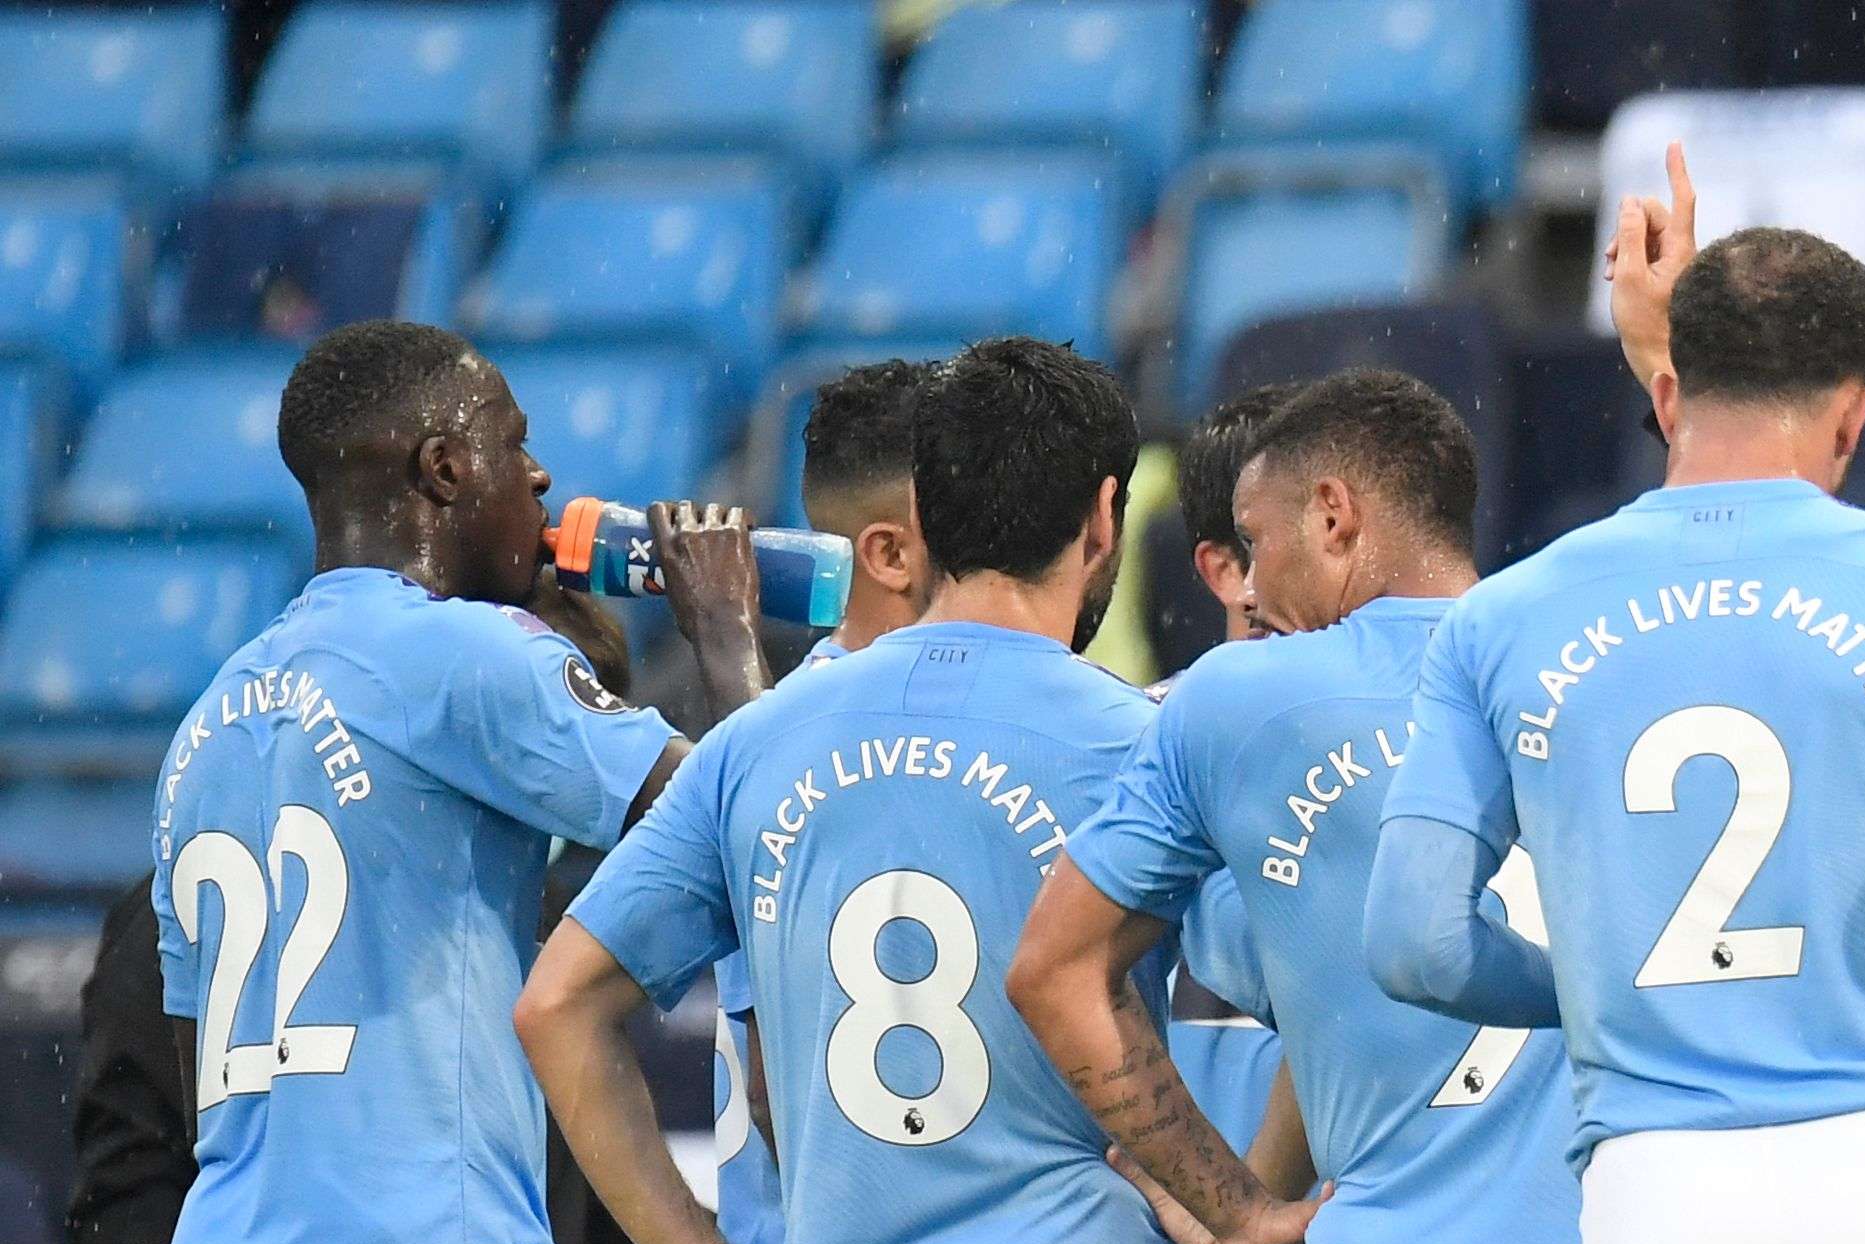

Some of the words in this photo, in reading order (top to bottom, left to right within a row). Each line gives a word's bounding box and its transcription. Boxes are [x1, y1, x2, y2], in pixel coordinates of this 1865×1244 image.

[1693, 509, 1734, 523] CITY
[928, 648, 970, 664] CITY
[1517, 616, 1622, 761] BLACK
[1627, 579, 1761, 634] LIVES
[160, 712, 212, 861] BLACK
[220, 670, 293, 726] LIVES
[290, 671, 372, 808] MATTER
[753, 770, 827, 924] BLACK
[831, 736, 957, 788] LIVES
[963, 750, 1068, 876] MATT
[1262, 740, 1373, 888] BLACK
[1621, 704, 1805, 990] 2
[171, 804, 358, 1113] 22
[825, 868, 992, 1146] 8
